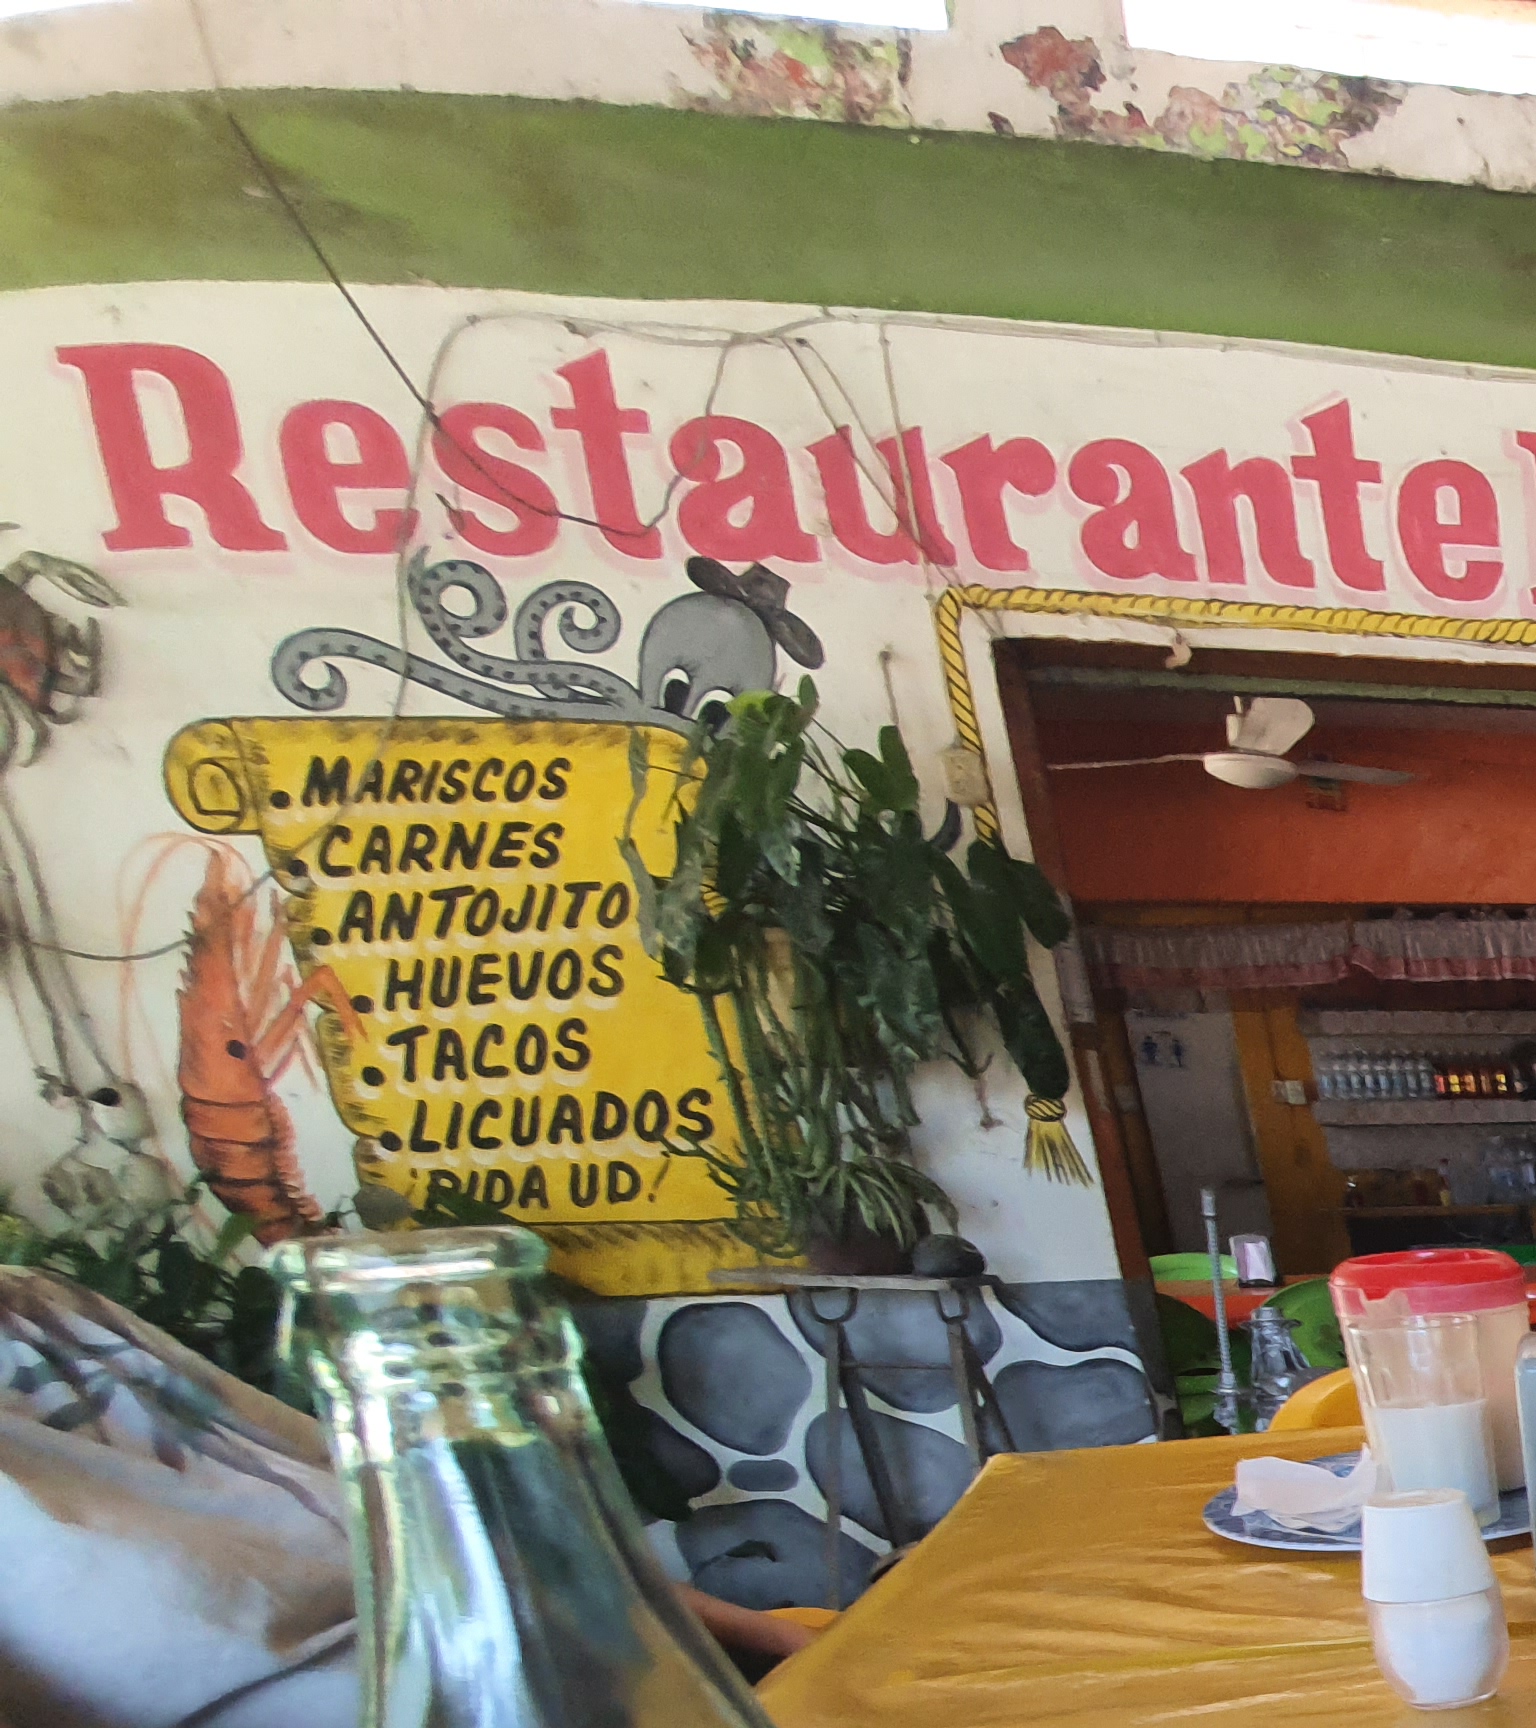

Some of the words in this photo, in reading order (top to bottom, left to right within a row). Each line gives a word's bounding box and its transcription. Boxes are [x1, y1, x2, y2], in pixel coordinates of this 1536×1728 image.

[56, 342, 1504, 602] Restaurante
[301, 756, 571, 808] MARISCOS
[317, 821, 564, 877] CARNES
[337, 880, 632, 944] ANTOJITO
[384, 944, 624, 1012] HUEVOS
[386, 1018, 592, 1083] TACOS
[408, 1087, 714, 1152] LICUADOS
